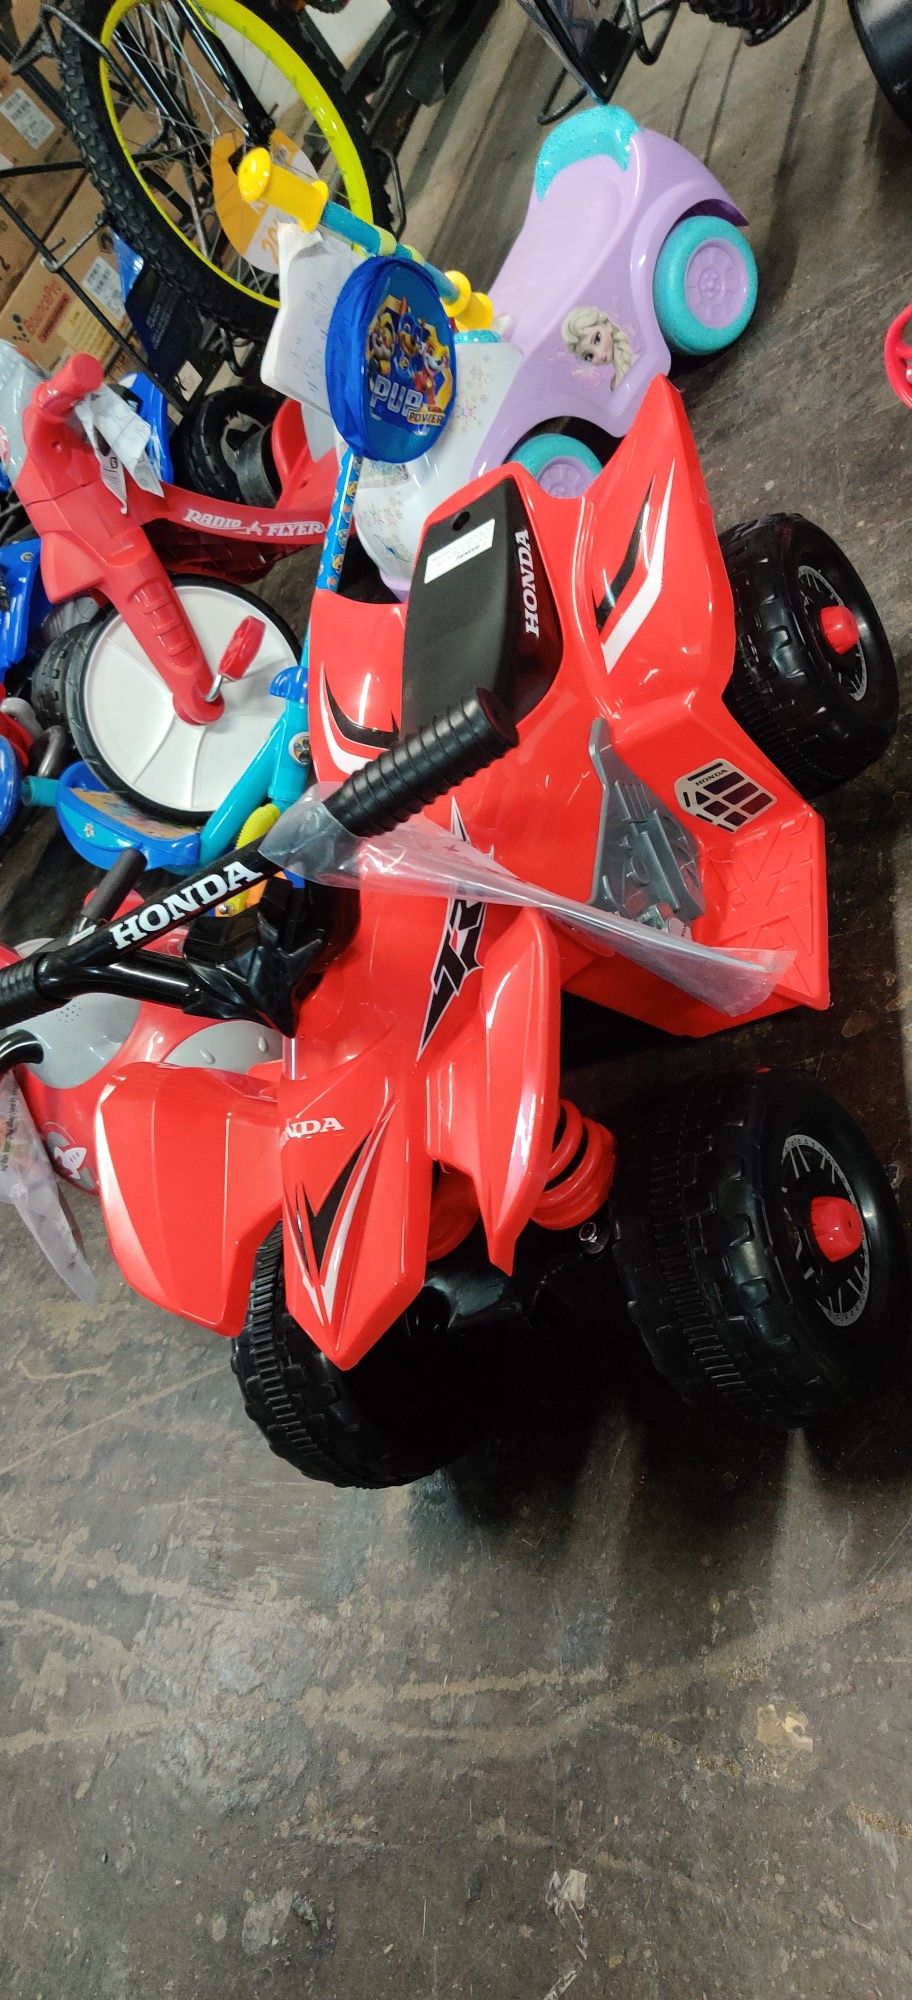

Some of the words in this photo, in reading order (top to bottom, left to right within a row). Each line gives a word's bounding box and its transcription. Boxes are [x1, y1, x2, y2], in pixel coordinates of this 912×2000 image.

[370, 374, 424, 417] PUP
[407, 411, 443, 425] POWER
[266, 521, 326, 537] FLYER
[515, 527, 539, 638] HONDA
[695, 768, 729, 787] HONDA
[109, 860, 263, 949] HONDA
